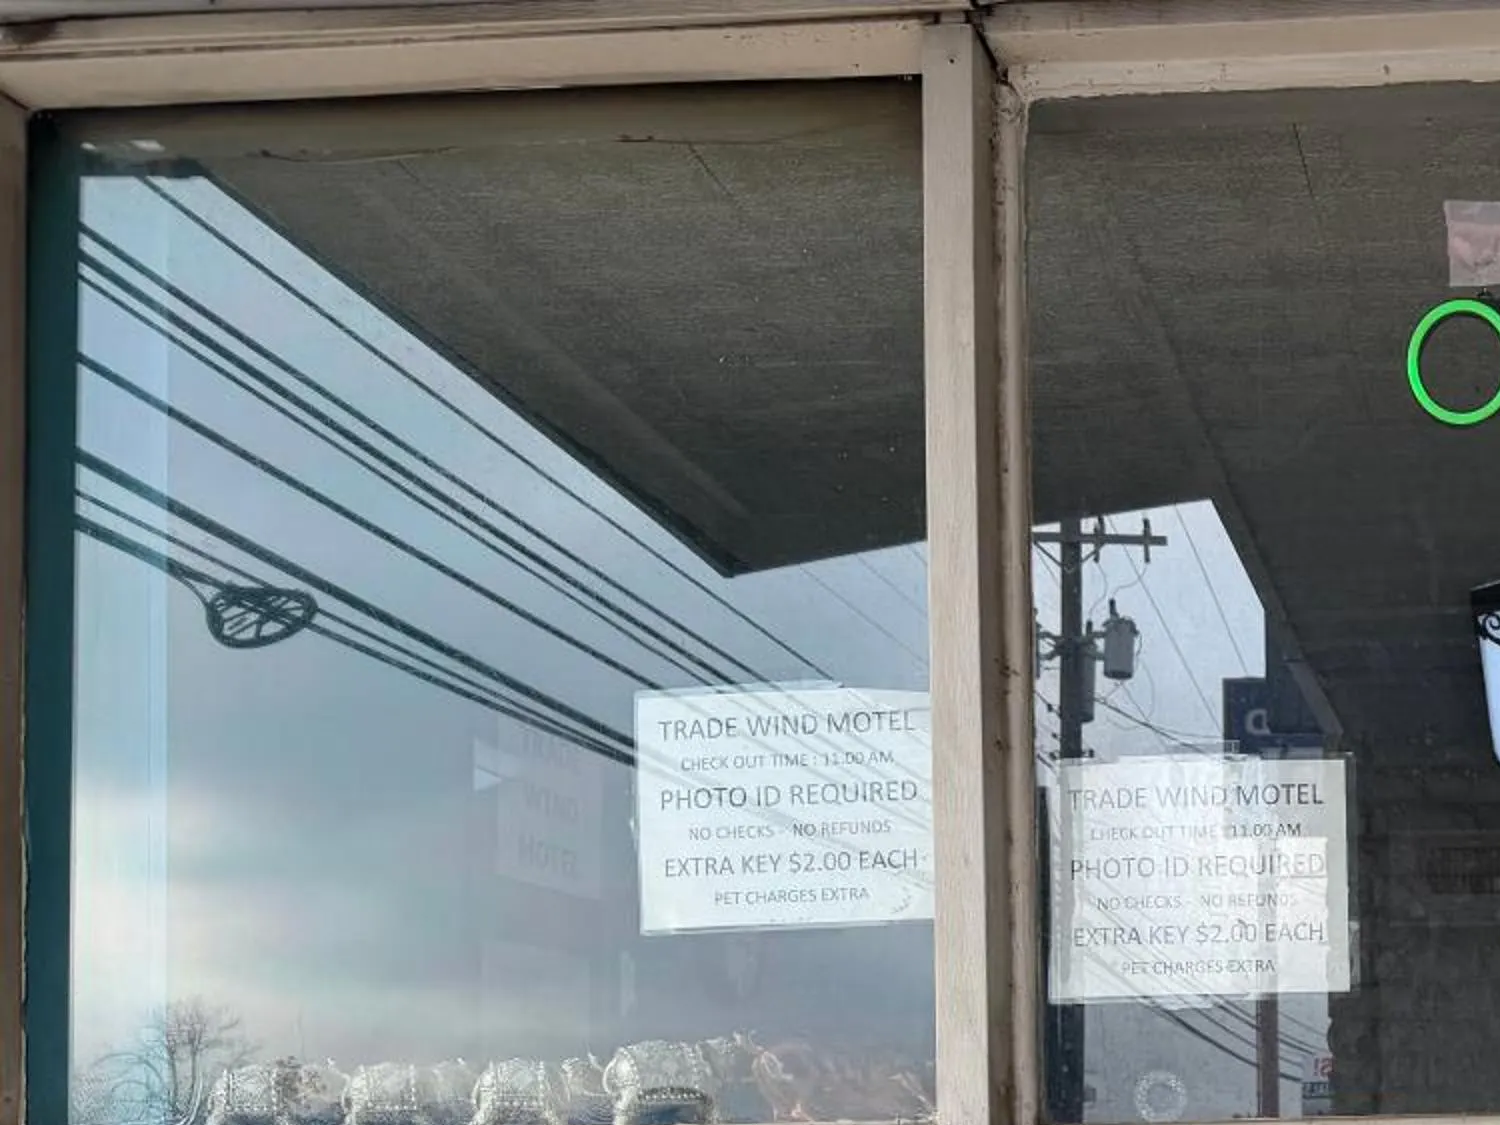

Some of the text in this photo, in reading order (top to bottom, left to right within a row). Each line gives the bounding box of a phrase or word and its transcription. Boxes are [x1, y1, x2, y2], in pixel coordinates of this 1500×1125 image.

[657, 710, 915, 742] TRADE WIND MOTEL
[681, 754, 729, 772] CHECK
[733, 754, 765, 770] OUT
[771, 753, 809, 769] TIME
[867, 750, 895, 765] AM
[660, 780, 919, 811] PHOTO ID REQUIRED
[1068, 782, 1326, 811] TRADE WIND MOTEL
[688, 819, 892, 842] NO CHECKS NO REFUNDS
[1090, 826, 1138, 843] CHECK
[1276, 822, 1302, 837] AM
[664, 848, 918, 878] EXTRA KEY $2.00 EACH
[1070, 852, 1325, 881] PHOTO ID REQUIRED
[714, 886, 870, 906] PET CHARGES EXTRA
[1096, 896, 1121, 912] NO
[1124, 894, 1183, 911] CHECKS
[1199, 894, 1224, 909] NO
[1073, 920, 1325, 948] EXTRA KEY $2.00 EACH
[1151, 959, 1224, 976] CHARGES
[1225, 958, 1276, 974] EXTRA
